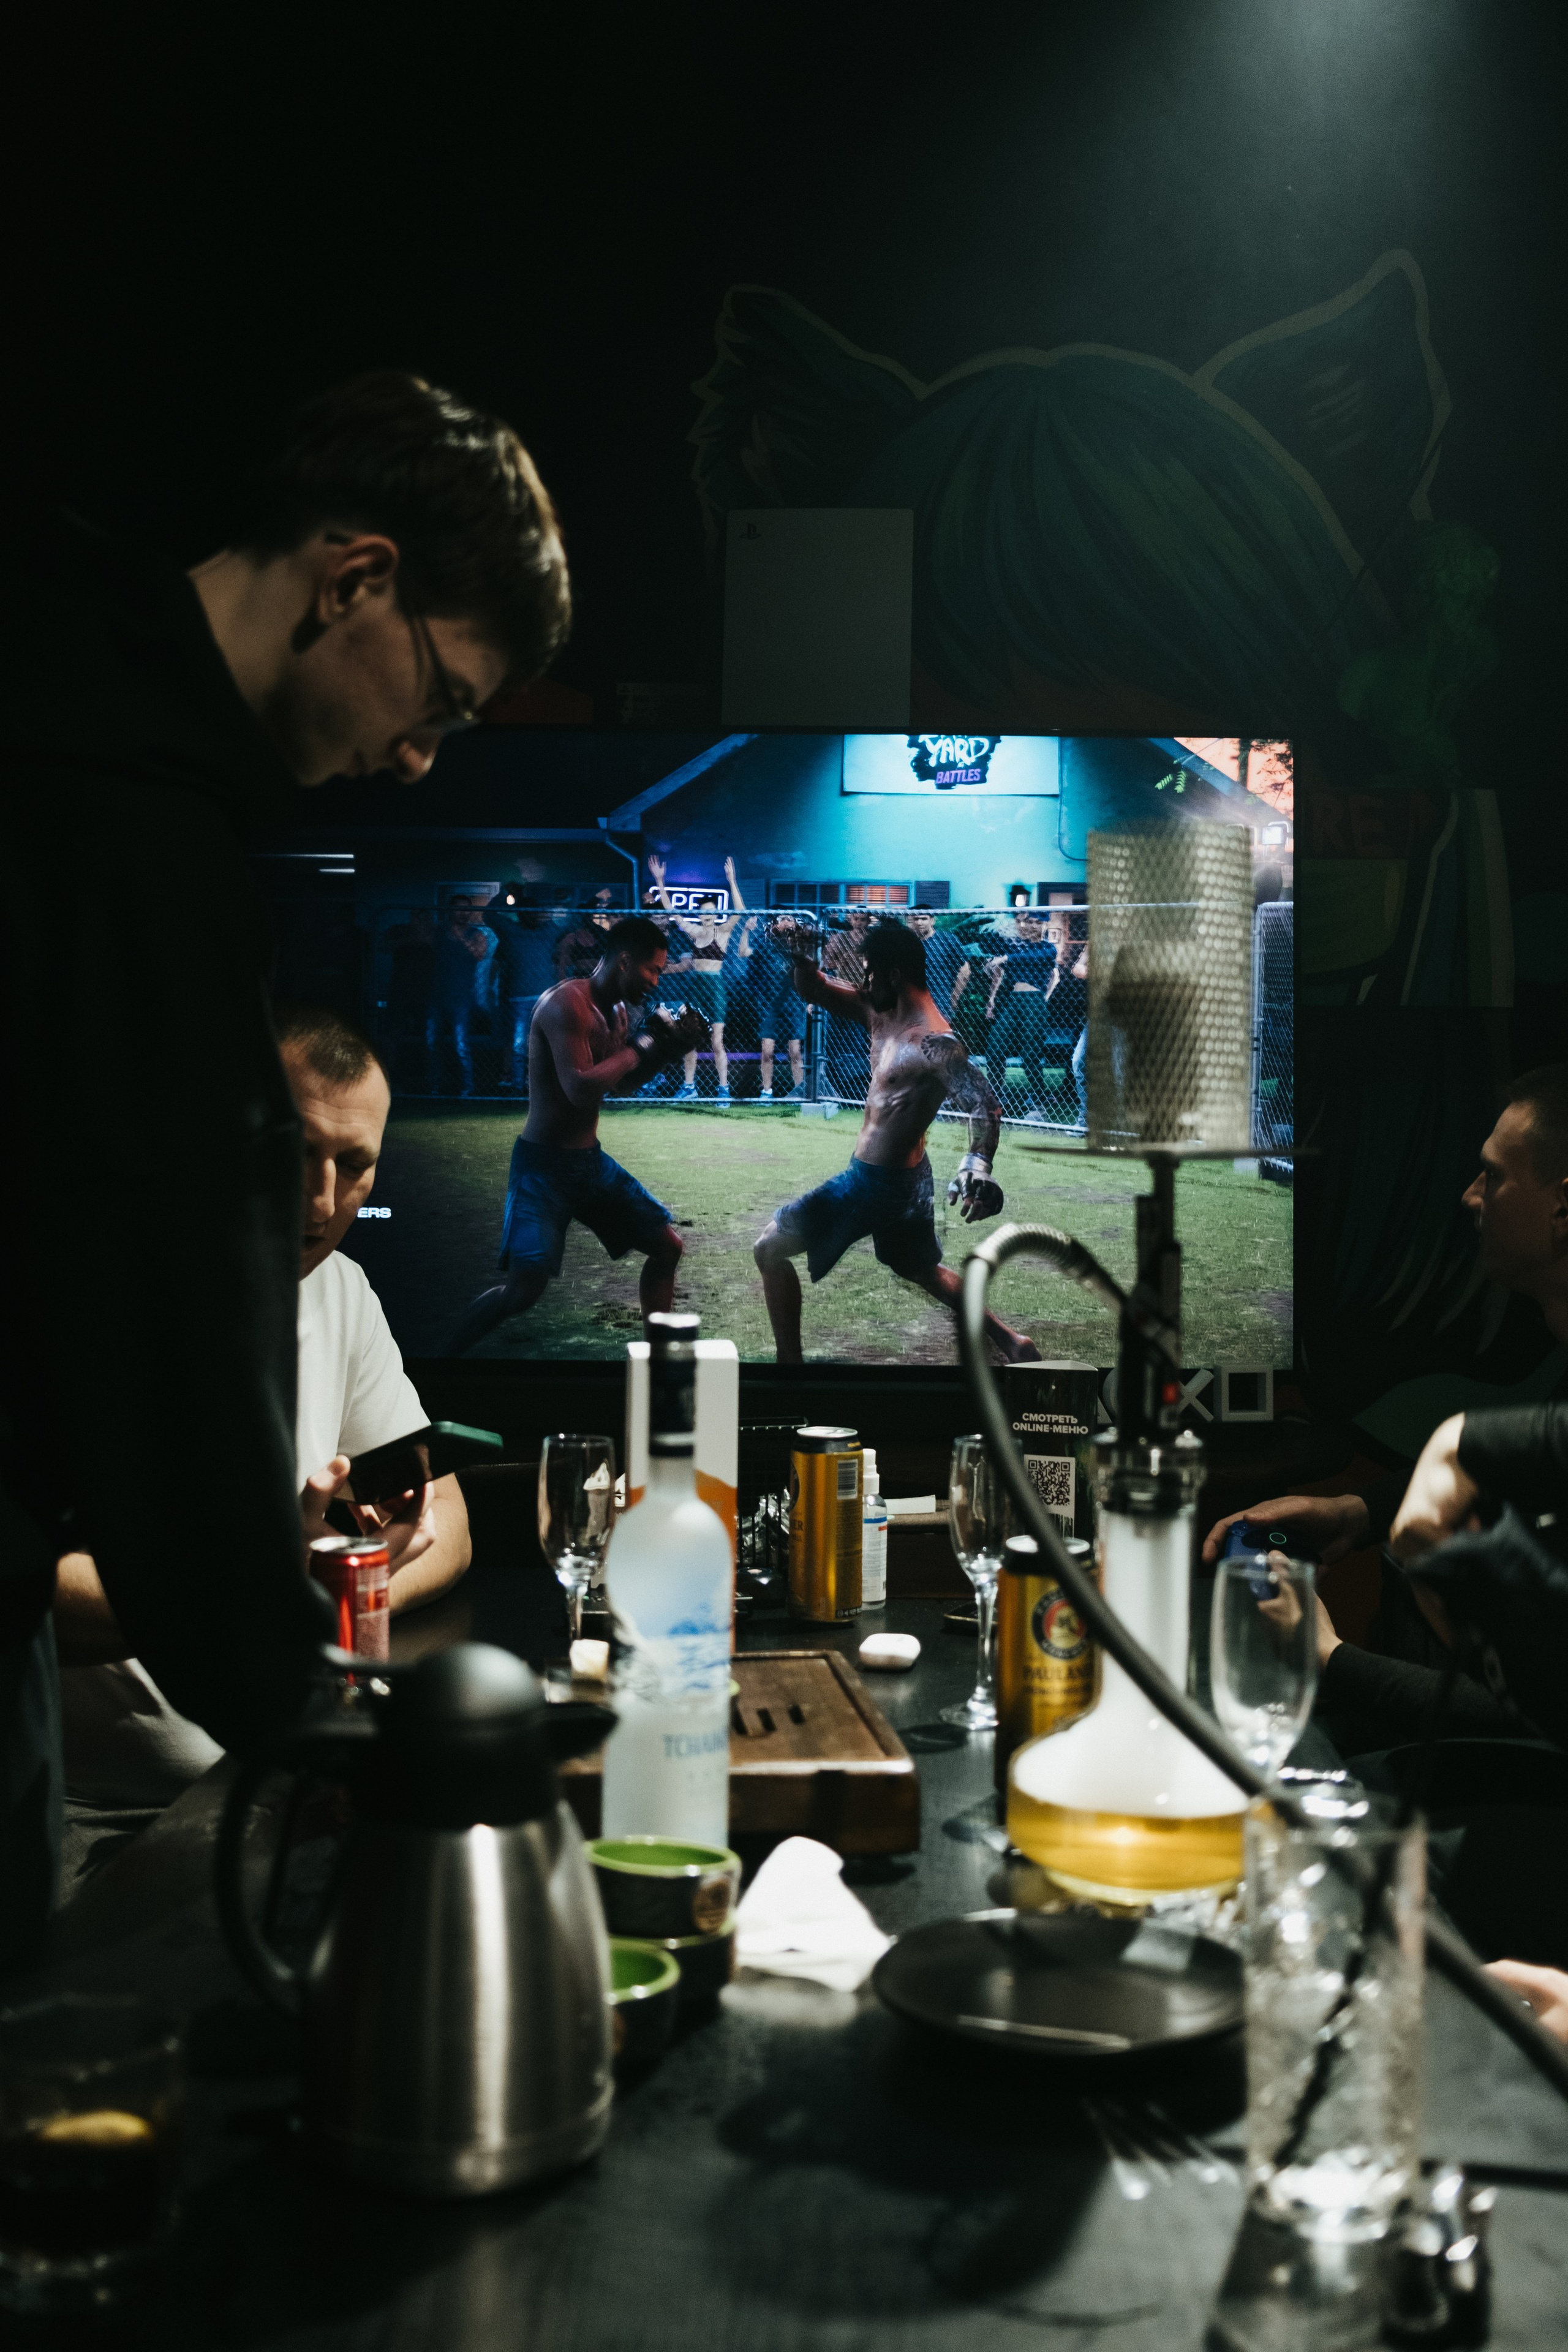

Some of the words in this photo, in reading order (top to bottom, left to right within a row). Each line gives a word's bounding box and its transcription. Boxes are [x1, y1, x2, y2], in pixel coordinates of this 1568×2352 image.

[919, 736, 989, 766] YARD
[935, 768, 981, 784] BATTLES
[1022, 1412, 1078, 1424] СМОТРЕТЬ
[1012, 1422, 1088, 1434] ONLINE-МЕНЮ
